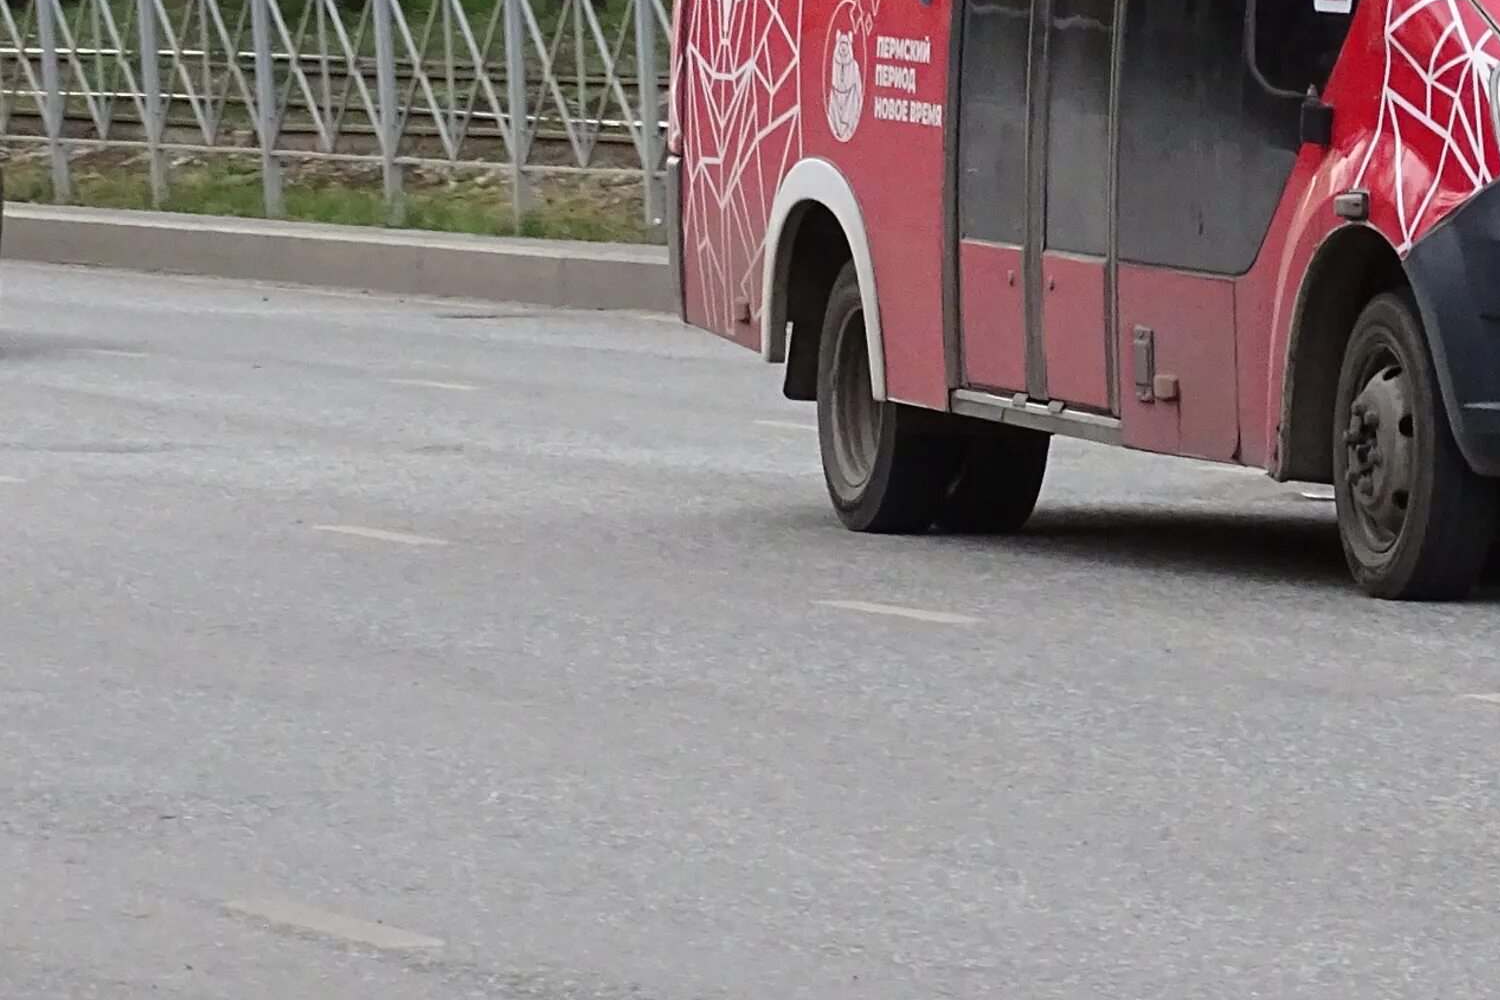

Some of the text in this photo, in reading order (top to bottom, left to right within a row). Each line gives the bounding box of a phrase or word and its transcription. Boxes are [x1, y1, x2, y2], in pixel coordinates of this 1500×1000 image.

[876, 36, 931, 63] ПЕРМСКИЙ
[875, 64, 916, 94] ПЕРИОД
[874, 96, 942, 127] НОВОЕ ВРЕМЯ
